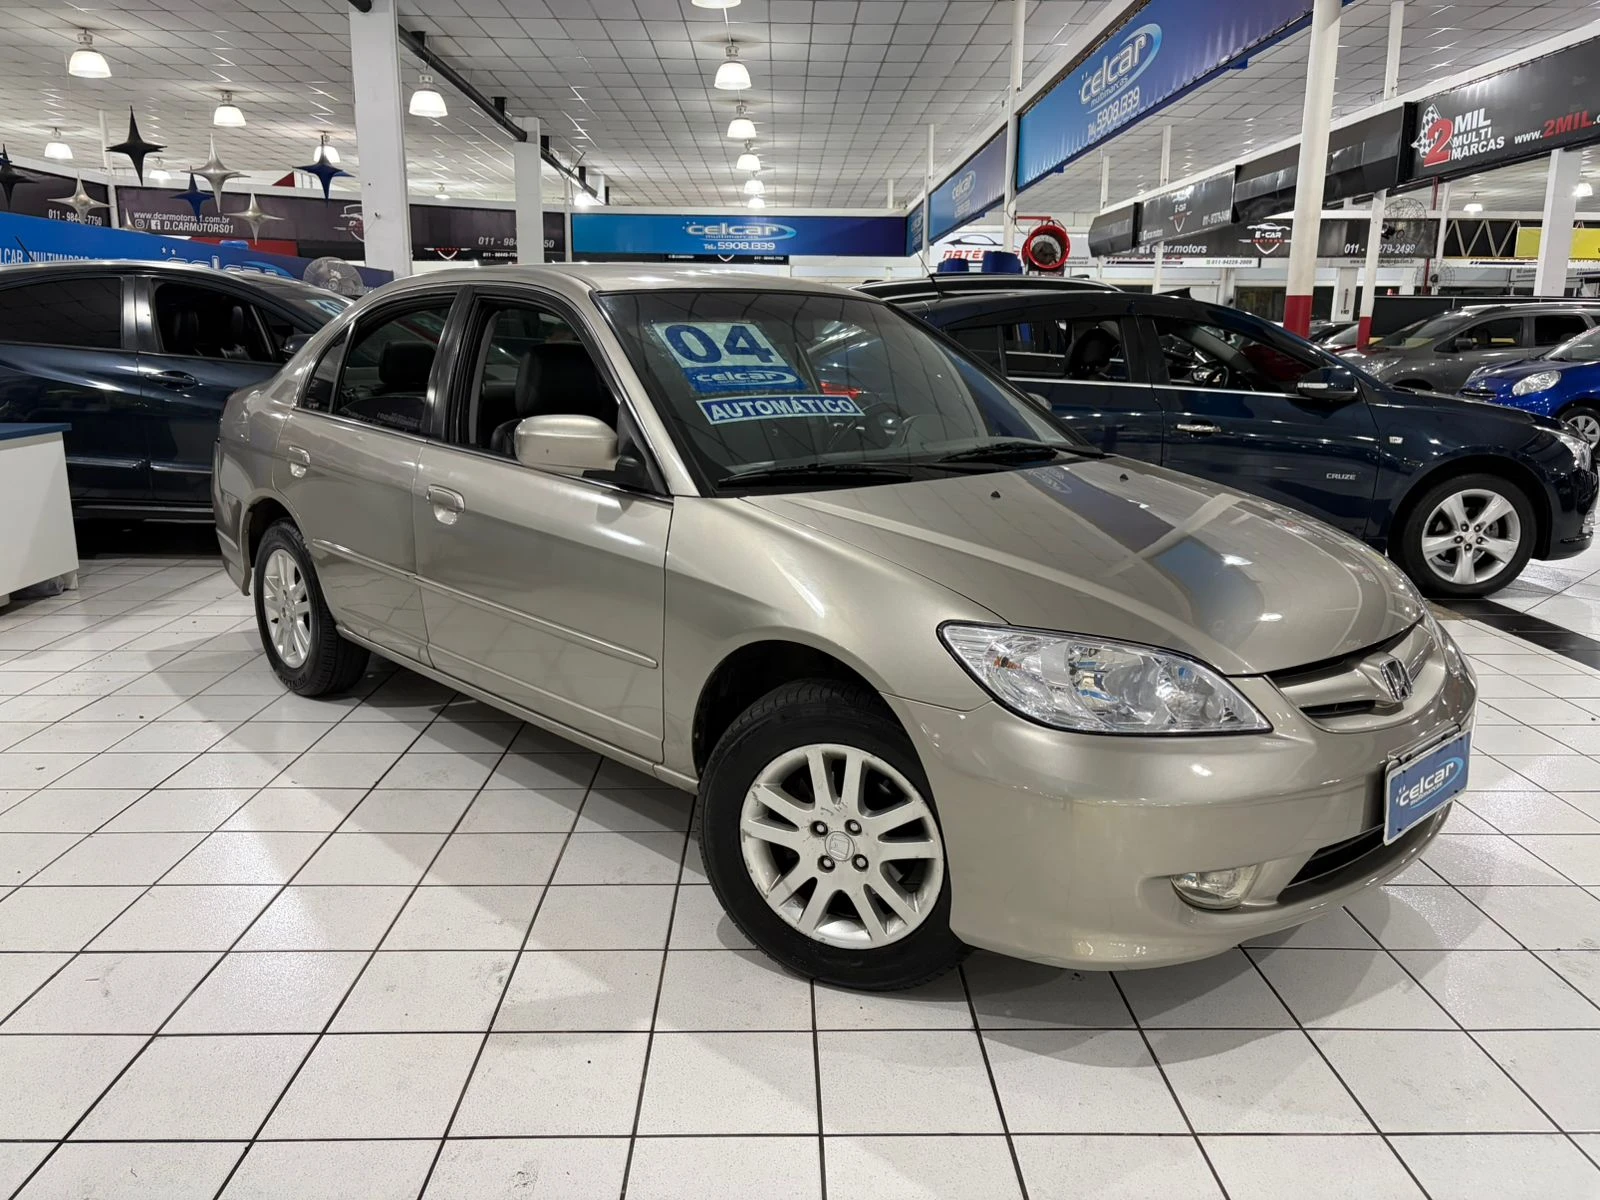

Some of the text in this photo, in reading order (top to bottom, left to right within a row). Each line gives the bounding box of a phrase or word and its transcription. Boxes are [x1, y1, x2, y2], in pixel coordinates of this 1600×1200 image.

[1080, 33, 1147, 105] celcar
[1424, 108, 1491, 167] 2 MIL
[1451, 136, 1505, 160] MARCAS
[1453, 127, 1492, 148] MULTI
[48, 209, 60, 219] 011
[686, 223, 779, 236] celcar
[478, 236, 494, 246] 011
[1344, 243, 1359, 254] 011
[665, 324, 775, 364] 04
[696, 371, 777, 383] celcar
[712, 396, 856, 421] AUTOMÁTICO
[1326, 472, 1357, 480] CRUZE
[1400, 762, 1455, 807] celcar
